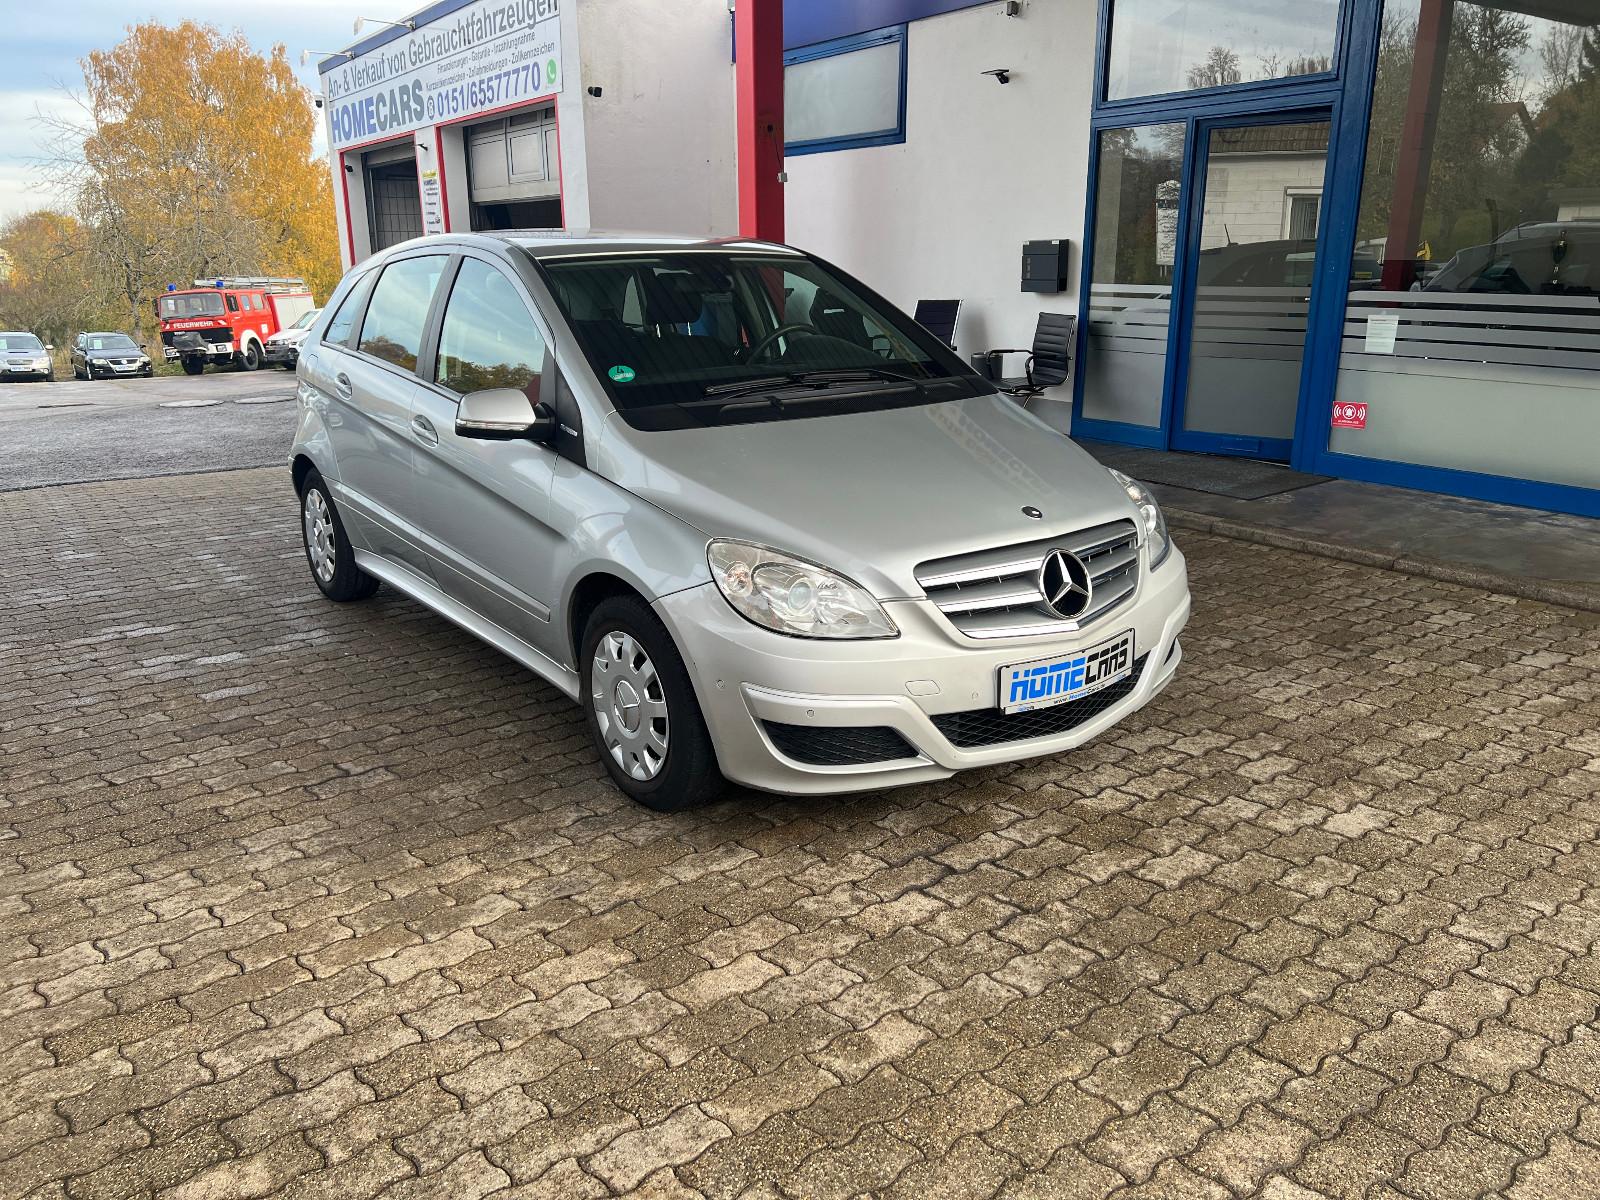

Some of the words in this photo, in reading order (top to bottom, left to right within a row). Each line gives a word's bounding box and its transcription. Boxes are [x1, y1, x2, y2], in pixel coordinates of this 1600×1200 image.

[328, 75, 342, 99] An-
[343, 67, 351, 92] &
[350, 52, 386, 88] Verkauf
[387, 49, 407, 76] von
[409, 0, 558, 66] Gebrauchtfahrzeugen
[330, 78, 425, 143] HOMECARS
[437, 61, 541, 117] 0151/65577770
[172, 320, 214, 329] FEUERWEHR
[1009, 638, 1129, 703] HOMECARS
